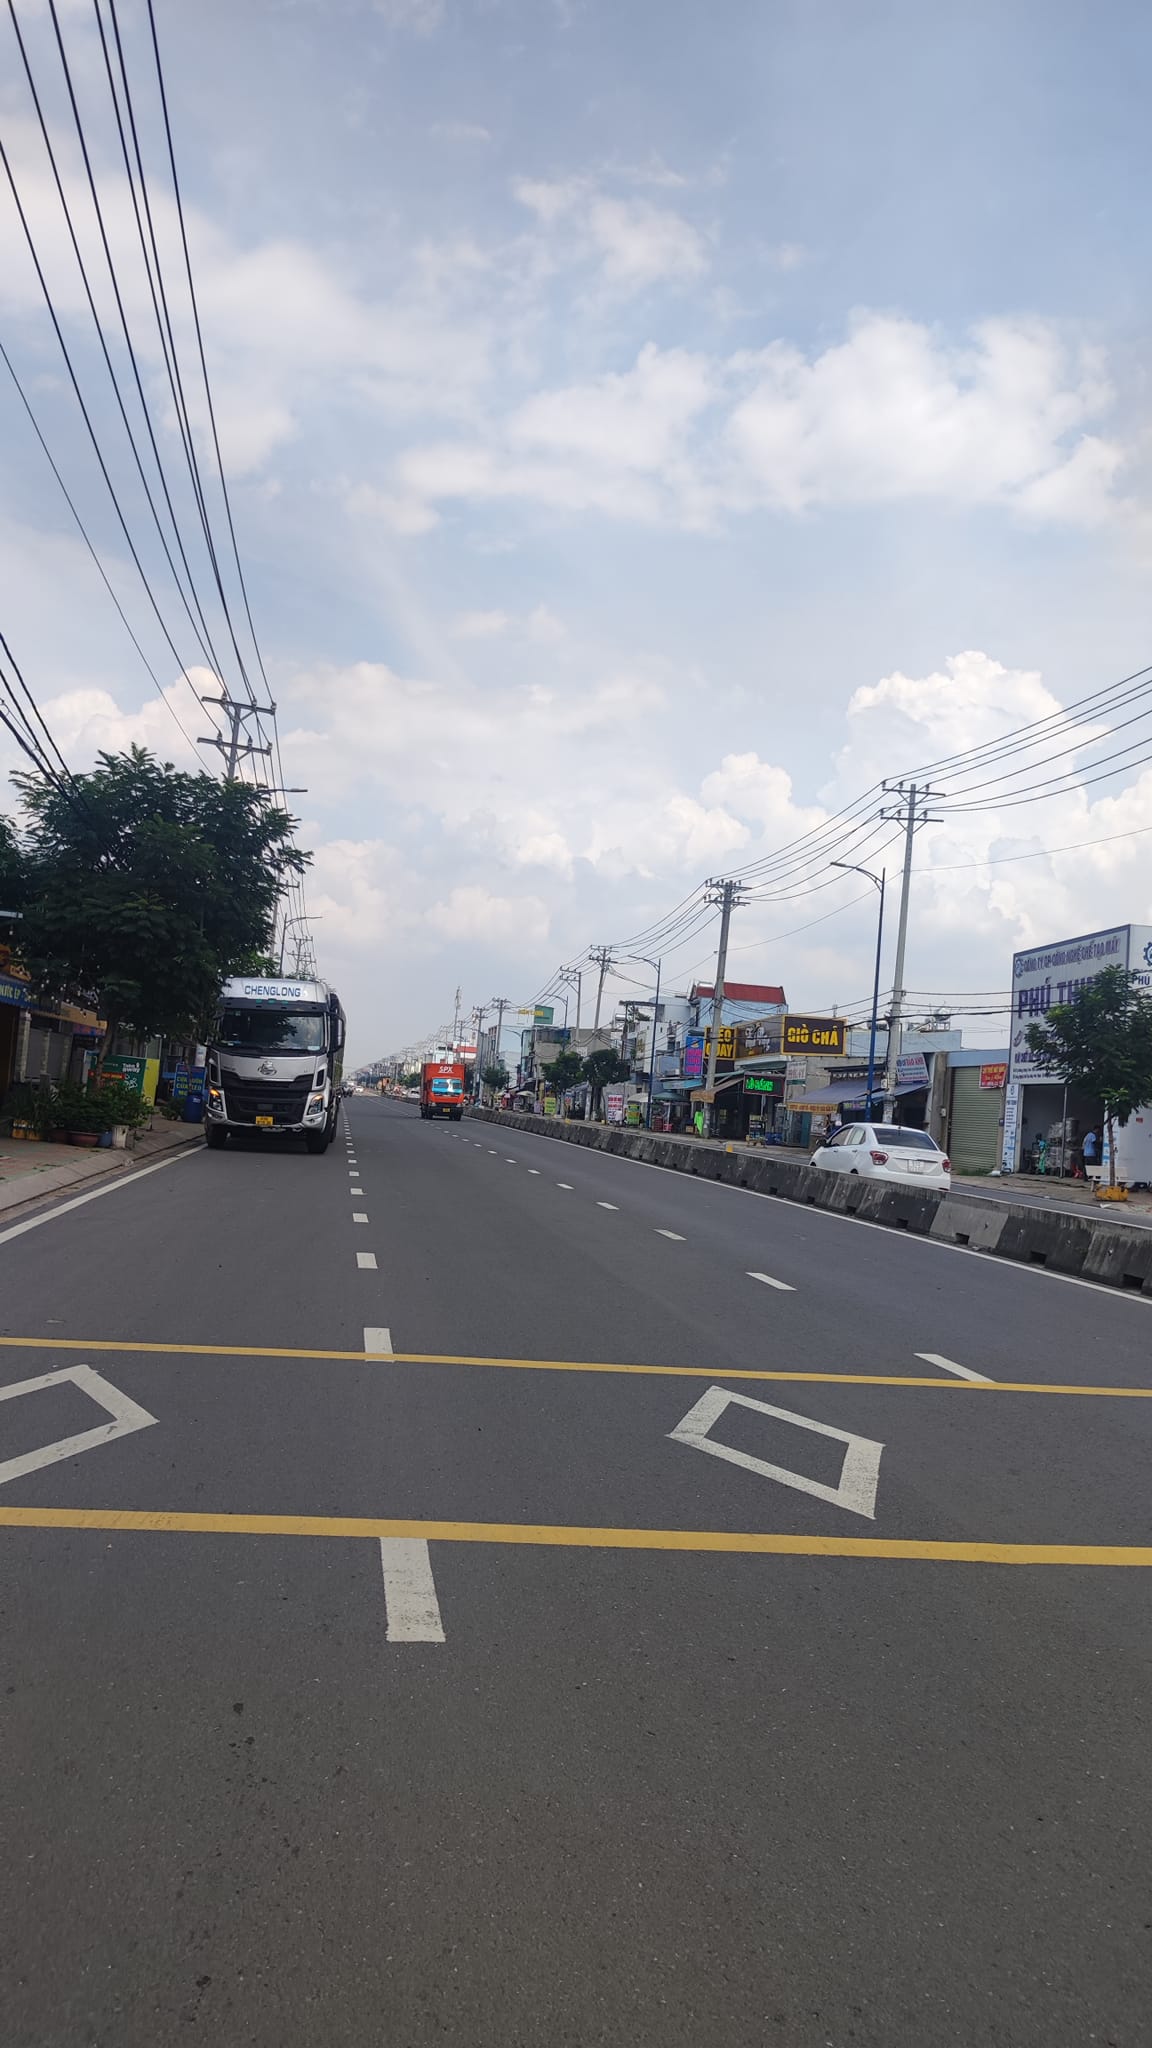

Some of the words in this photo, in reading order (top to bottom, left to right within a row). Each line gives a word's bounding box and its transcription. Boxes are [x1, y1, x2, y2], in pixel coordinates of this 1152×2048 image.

[1132, 974, 1151, 986] PHÚ
[244, 985, 301, 997] CHENGLONG
[1018, 976, 1051, 1019] PHÚ
[788, 1024, 809, 1043] GIÒ
[812, 1025, 839, 1046] CHẢ
